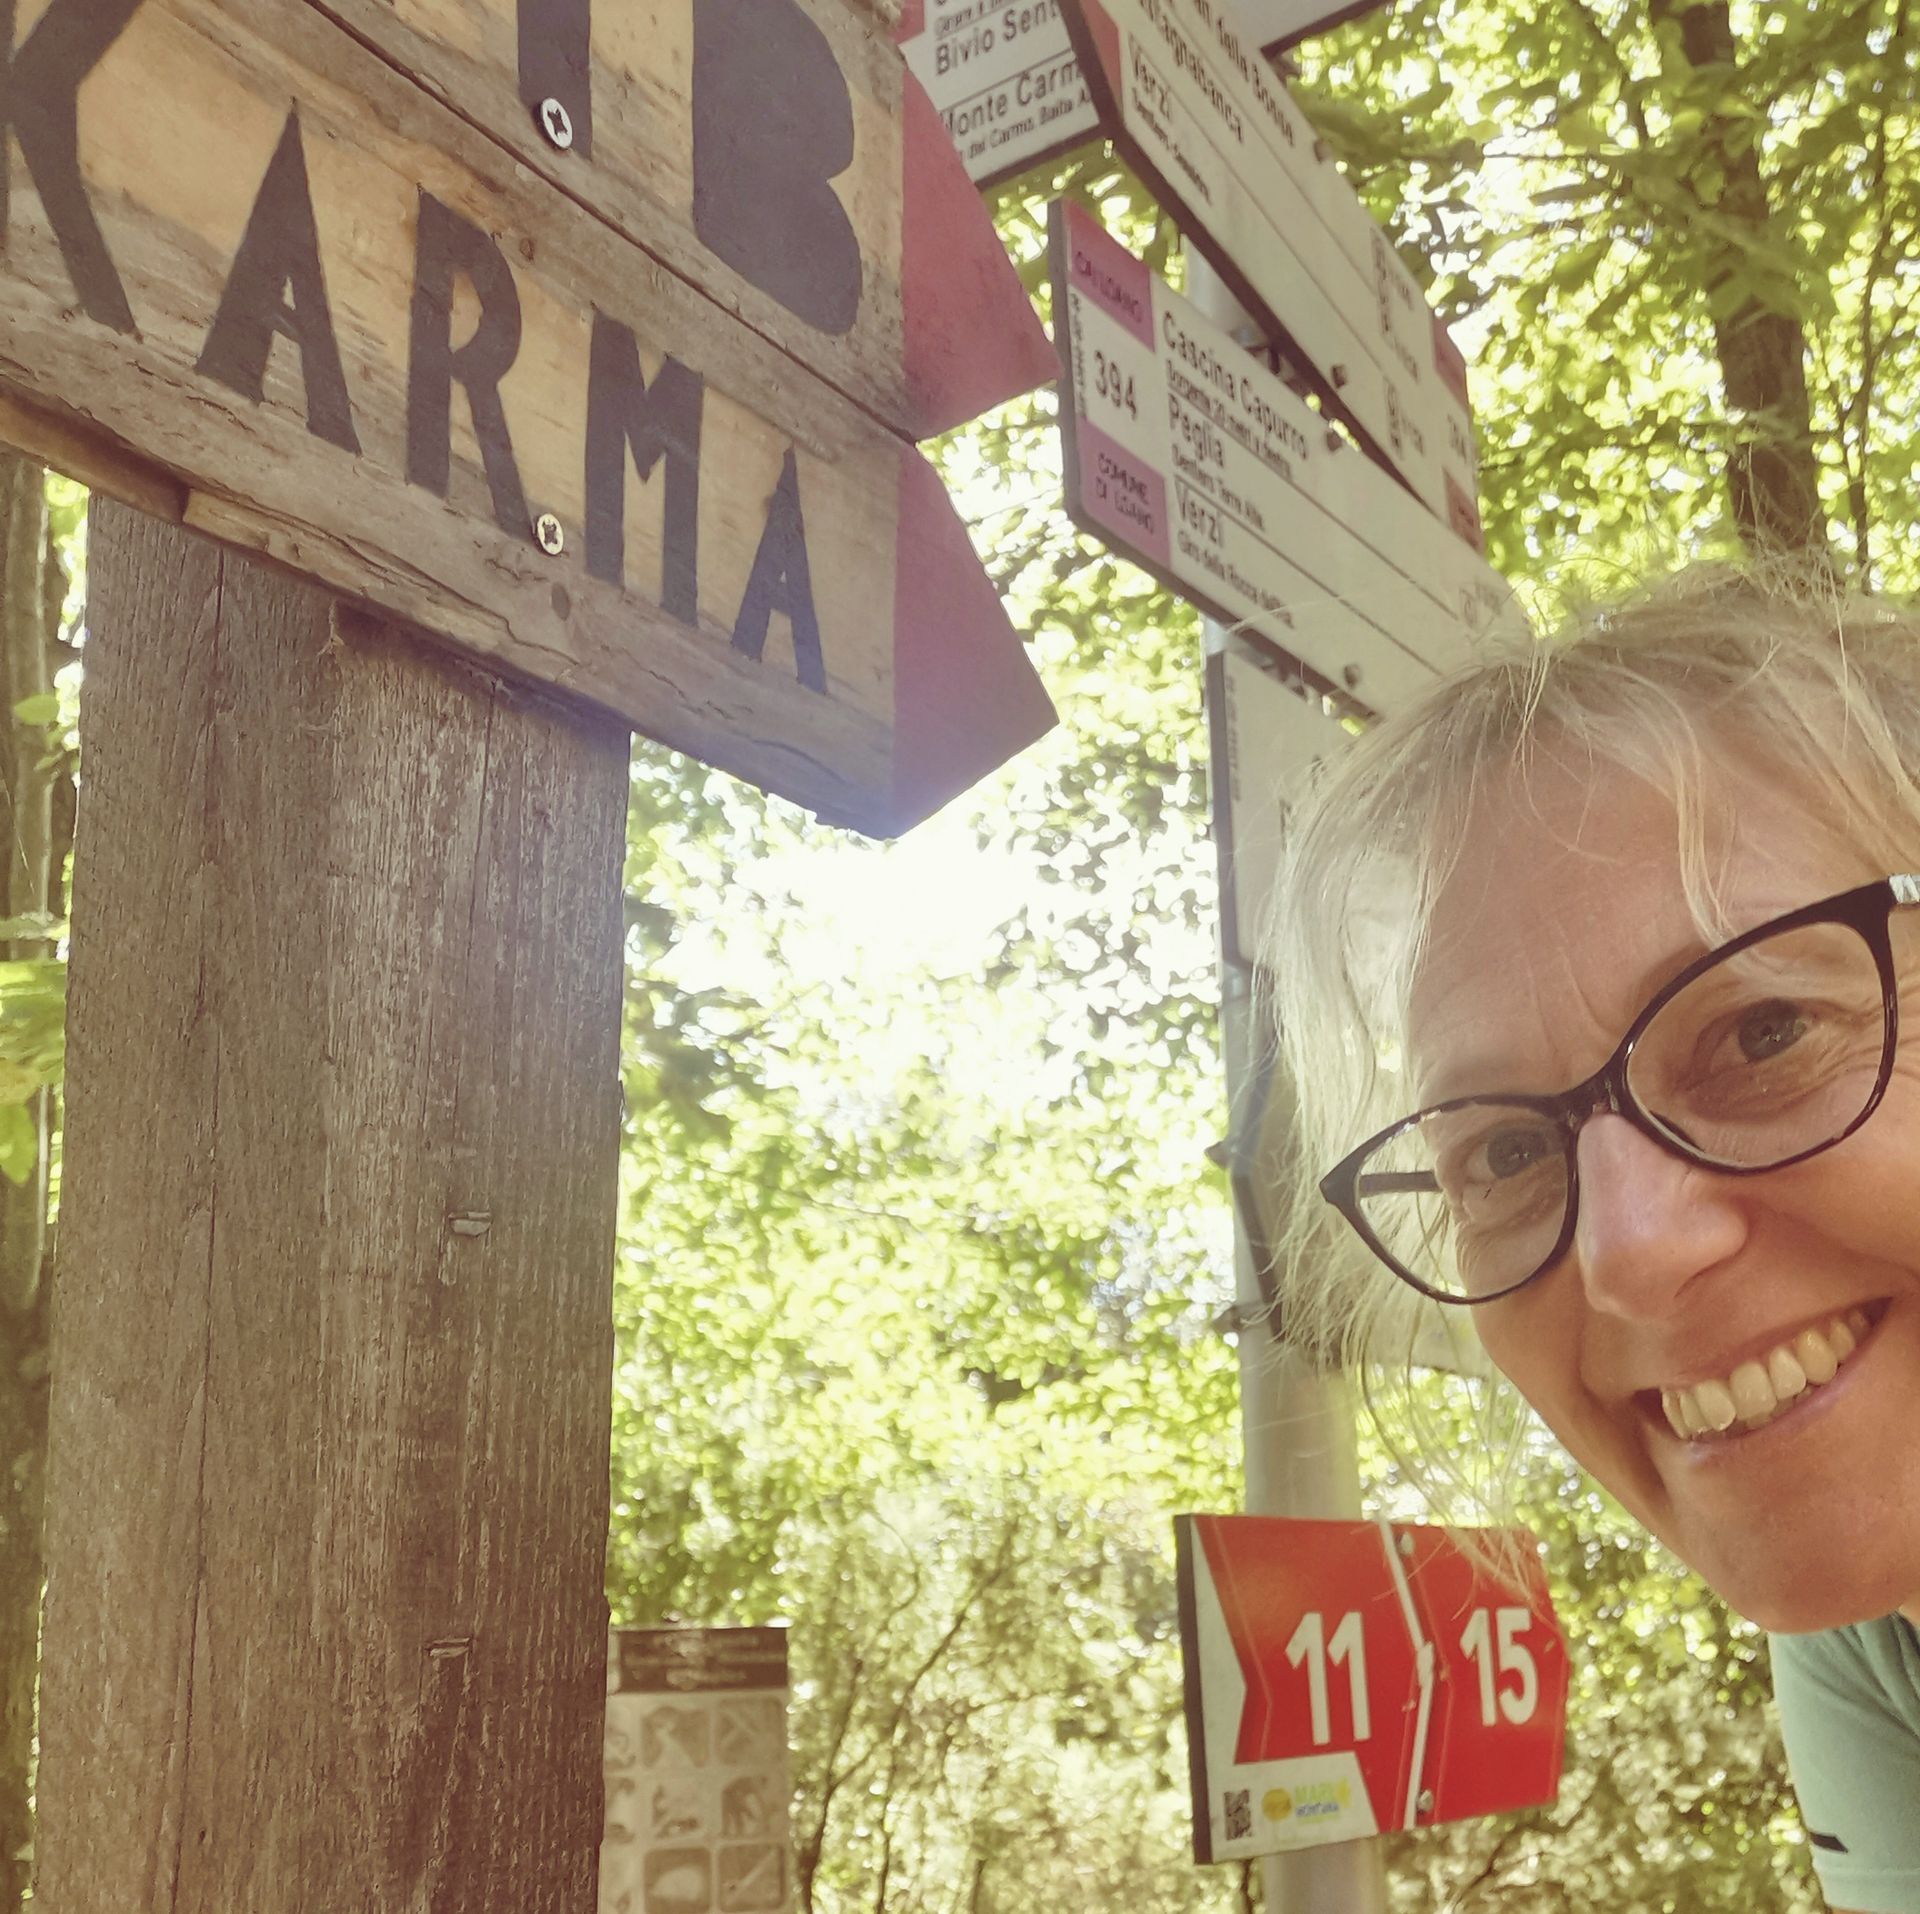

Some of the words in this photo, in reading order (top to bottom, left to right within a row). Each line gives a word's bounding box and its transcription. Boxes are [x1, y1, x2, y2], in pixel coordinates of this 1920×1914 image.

[935, 27, 994, 76] Bivio
[0, 0, 826, 694] KARMA
[1095, 349, 1137, 421] 394
[1163, 309, 1236, 401] Cascina
[1240, 378, 1309, 461] Capurro
[1168, 393, 1224, 469] Peglia
[1175, 476, 1223, 548] Verzi
[1285, 1611, 1371, 1746] 11
[1460, 1607, 1539, 1726] 15
